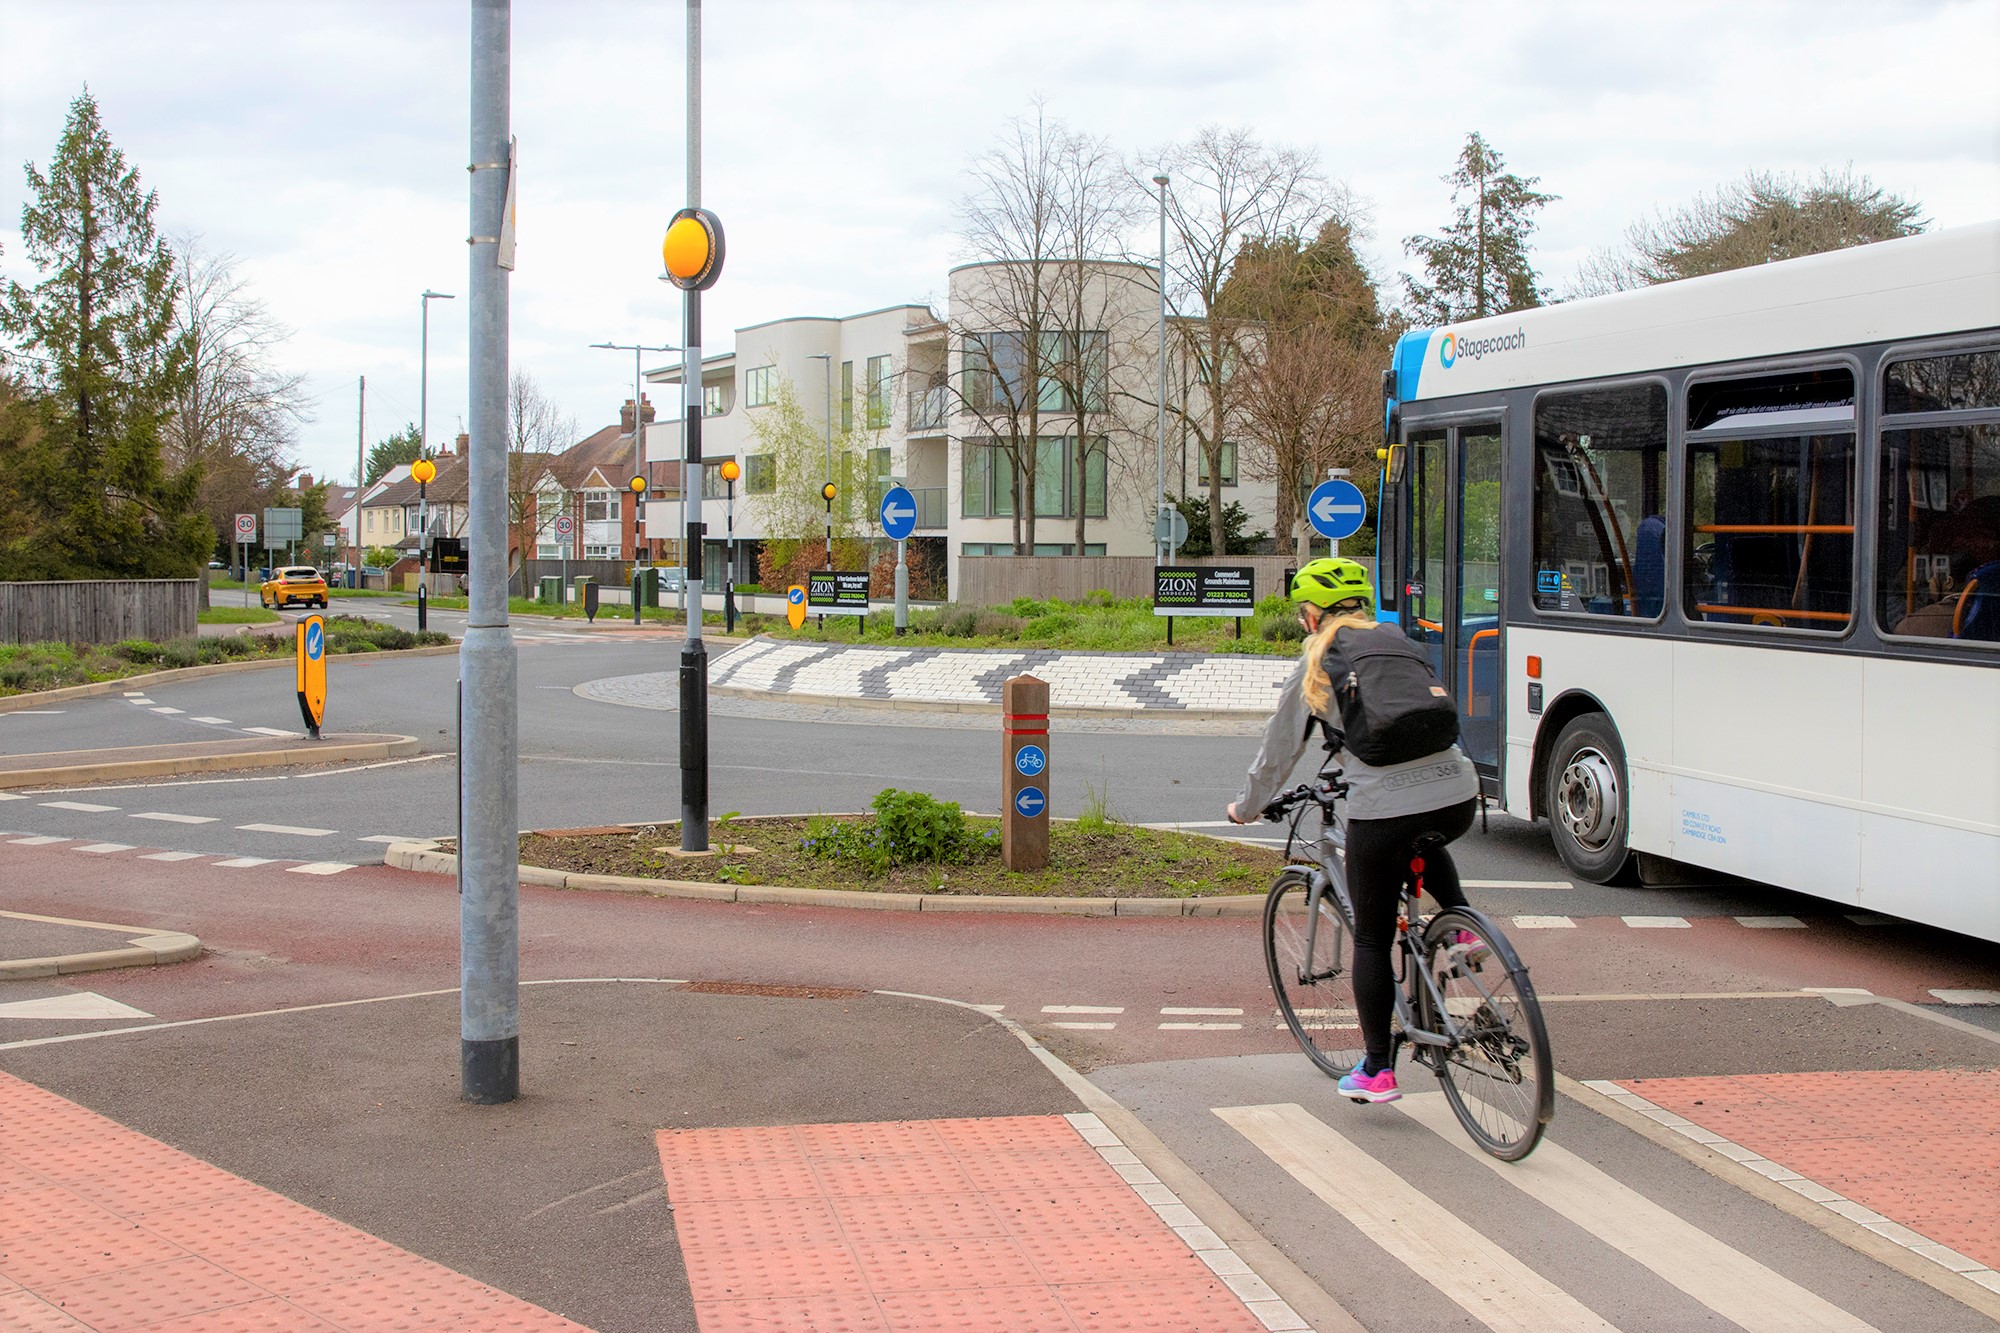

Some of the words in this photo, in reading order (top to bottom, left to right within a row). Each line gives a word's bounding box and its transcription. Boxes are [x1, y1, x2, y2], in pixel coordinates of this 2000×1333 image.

[1457, 326, 1525, 360] Stagecoach
[811, 582, 834, 592] ZION
[1159, 578, 1197, 591] ZION
[1682, 810, 1700, 820] CAMBUS
[1701, 814, 1709, 822] LTD
[1690, 820, 1707, 830] COWLEY
[1707, 825, 1721, 833] ROAD
[1682, 828, 1706, 839] CAMBRIDGE
